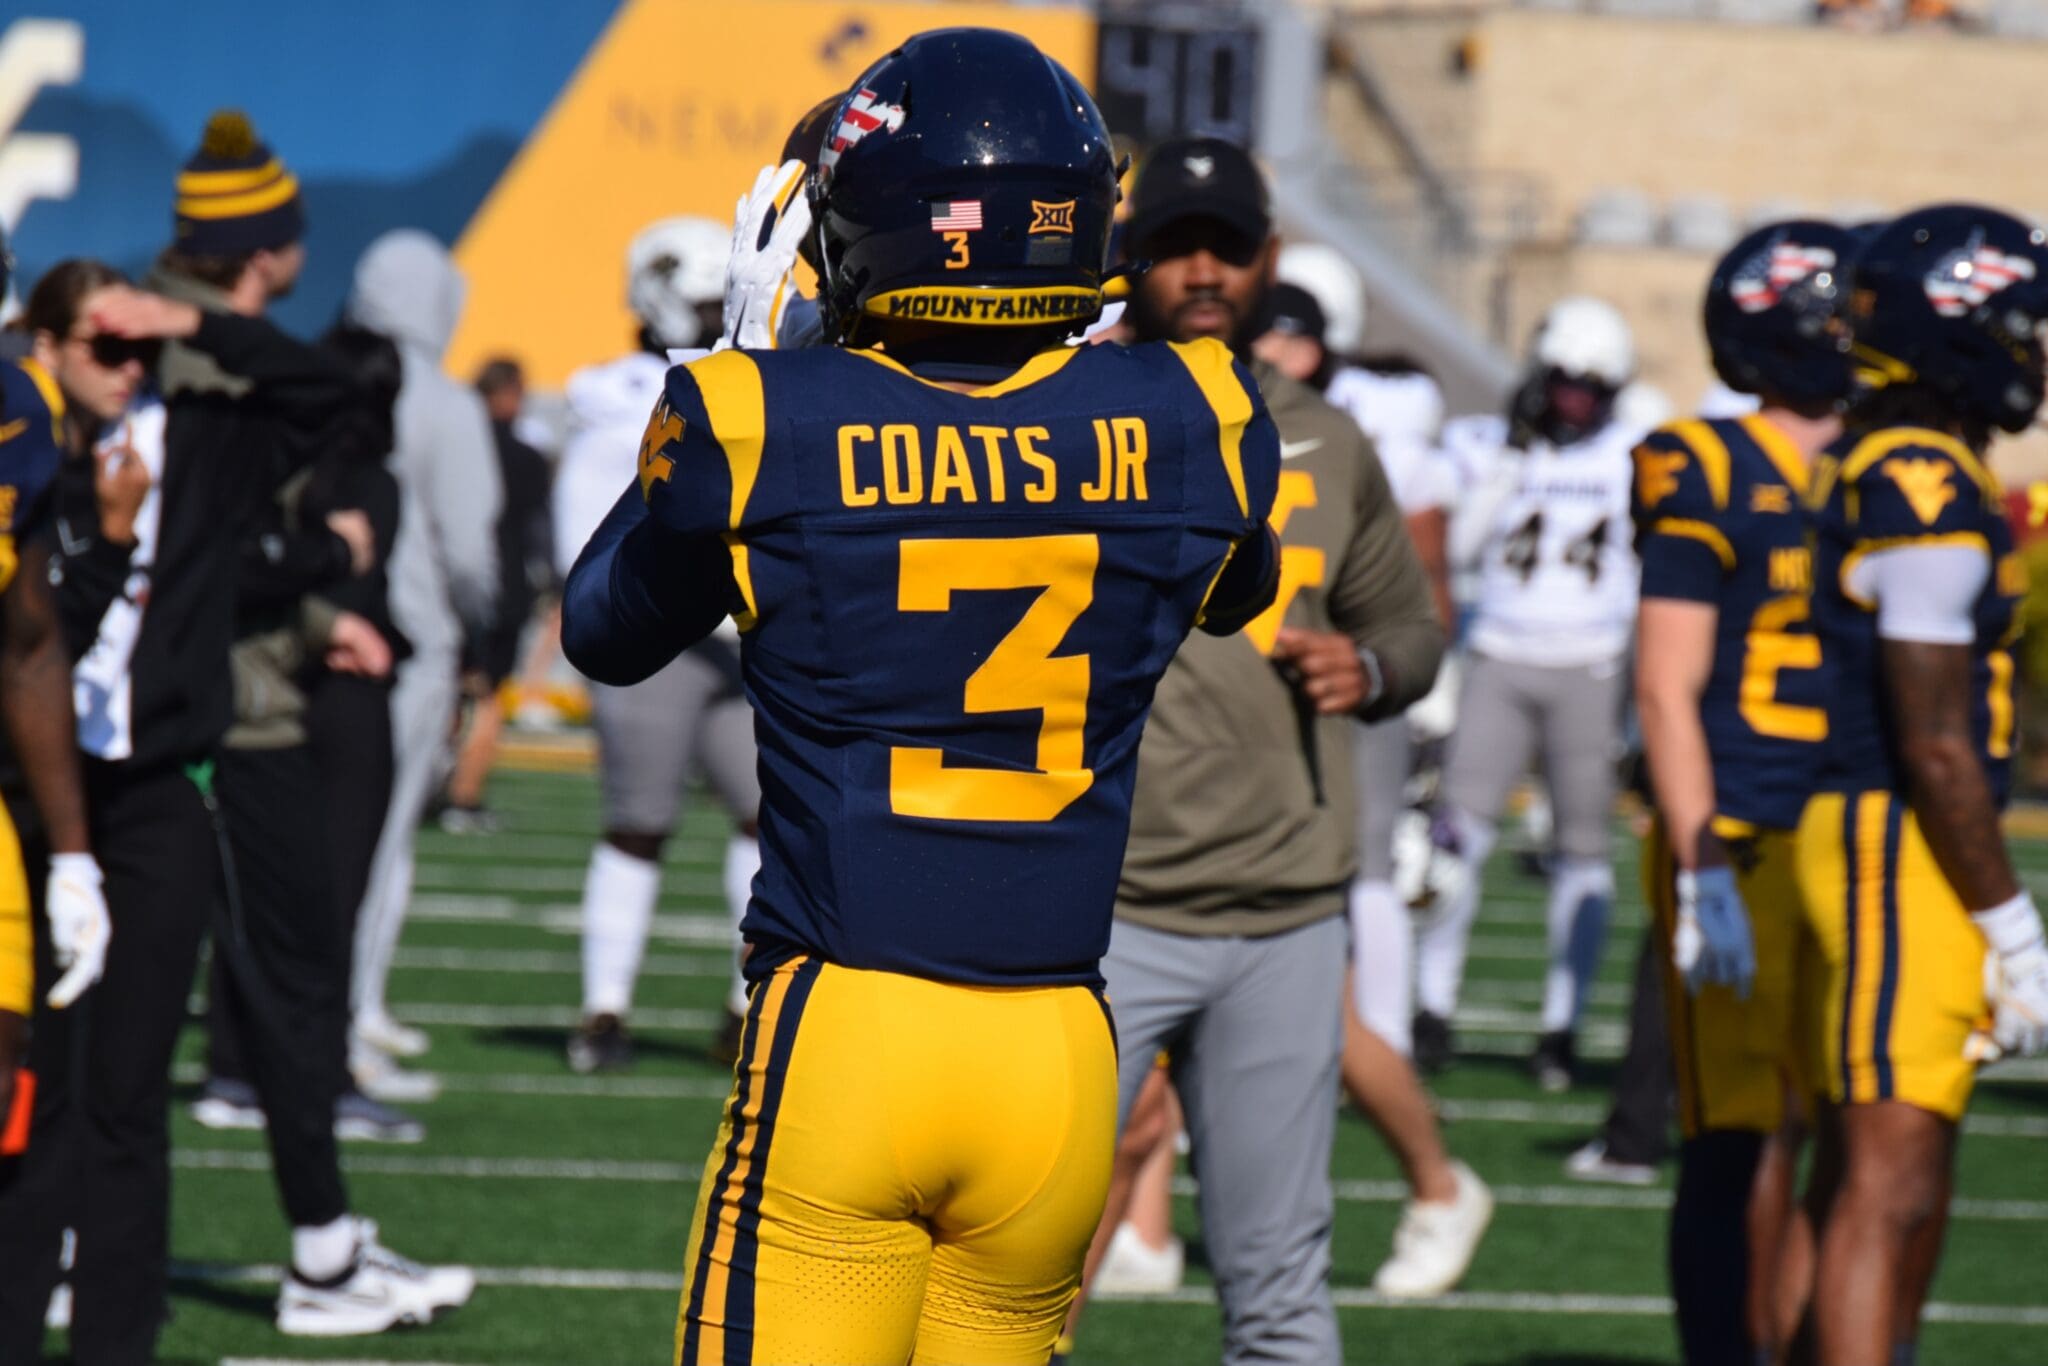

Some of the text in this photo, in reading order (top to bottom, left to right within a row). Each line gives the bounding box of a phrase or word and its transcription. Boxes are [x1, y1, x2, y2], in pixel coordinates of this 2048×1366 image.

[943, 231, 970, 269] 3
[837, 416, 1149, 507] COATS JR
[889, 533, 1099, 821] 3
